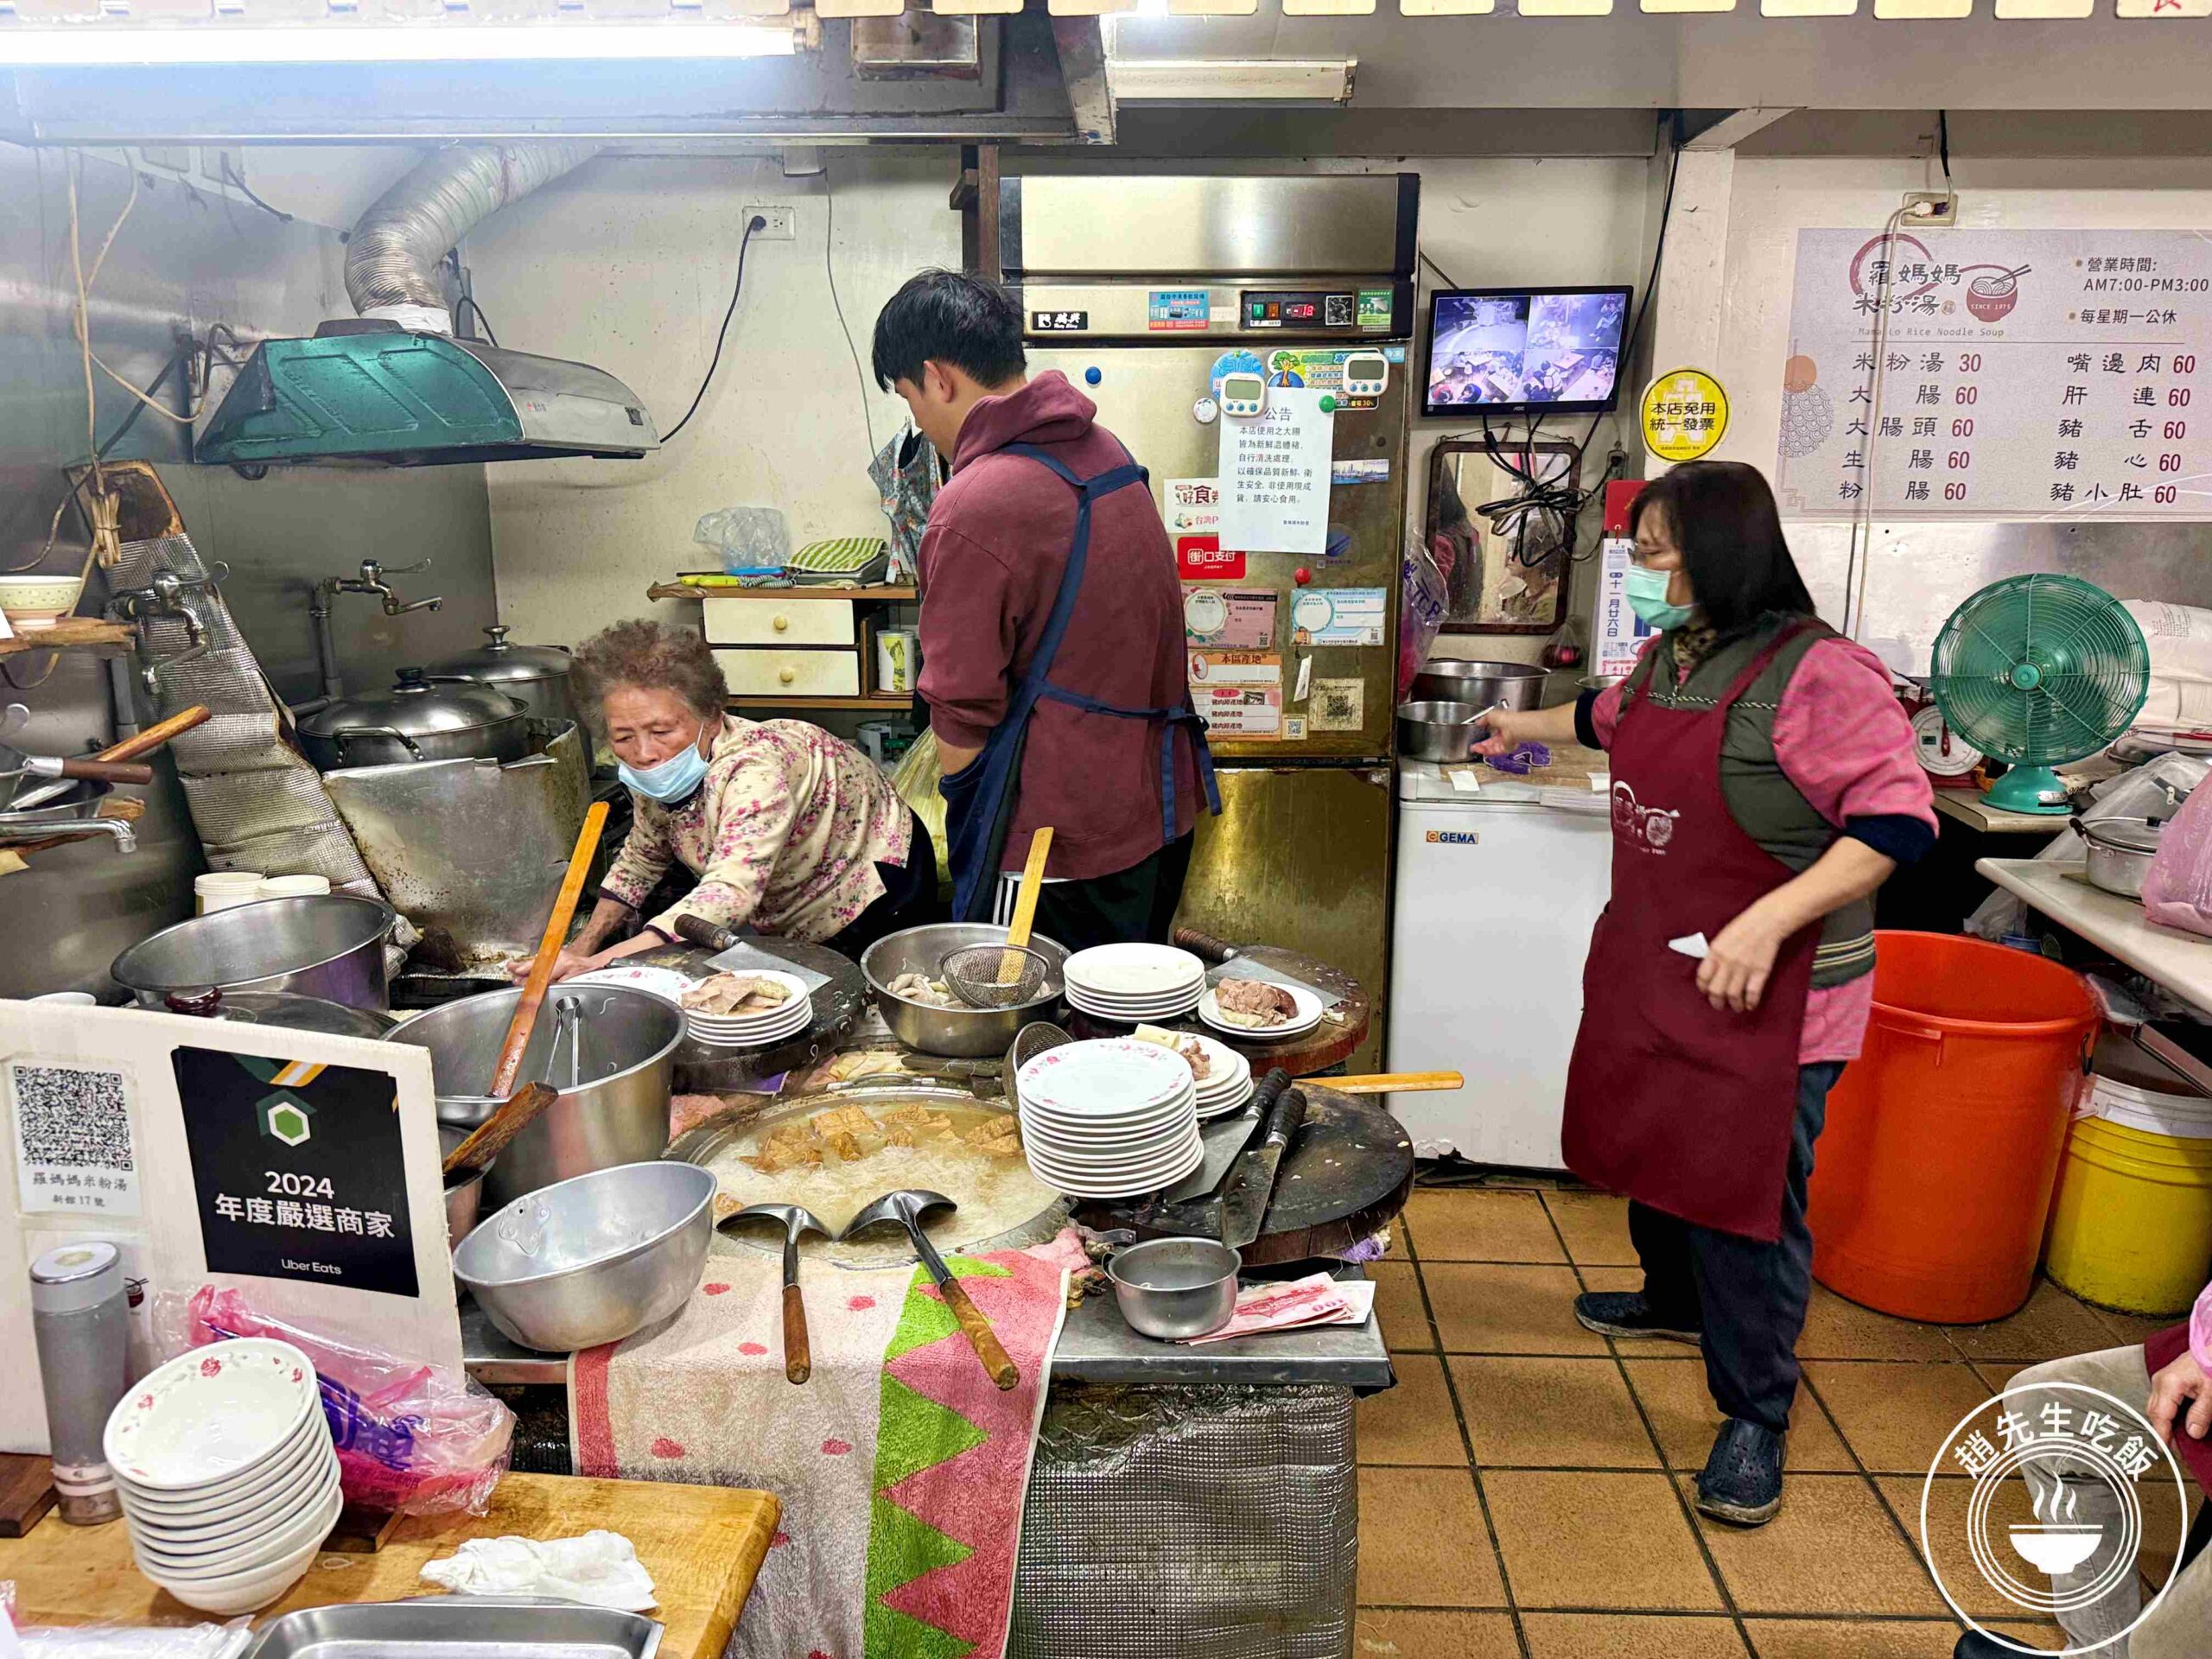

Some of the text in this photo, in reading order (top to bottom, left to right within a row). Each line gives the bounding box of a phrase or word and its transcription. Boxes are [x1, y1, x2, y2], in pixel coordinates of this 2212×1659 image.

[1868, 261, 1961, 286] 羅媽媽
[2088, 257, 2158, 272] 營業時間:
[2083, 278, 2209, 292] AM7:00-PM3:00
[1853, 292, 1941, 317] 米粉湯
[2081, 308, 2177, 324] 每星期一公休
[1889, 327, 1901, 336] Lo
[1907, 327, 1931, 336] Rice
[1937, 327, 1974, 336] Noodle
[1980, 327, 2004, 339] Soup
[1853, 353, 1981, 373] 米粉湯 30
[2067, 353, 2196, 373] 嘴邊肉 60
[1955, 386, 1977, 404] 60
[2168, 388, 2190, 406] 60
[1264, 406, 1293, 422] 公告
[1650, 402, 1716, 416] 本店免用
[1239, 426, 1300, 436] 本店使用之大腸
[1649, 417, 1715, 430] 統一發票
[1846, 416, 1974, 437] 大腸頭 60
[2164, 421, 2186, 439] 60
[1948, 451, 1970, 469] 60
[2159, 453, 2182, 472] 60
[1943, 483, 1967, 500] 60
[2050, 482, 2177, 504] 豬小肚 60
[1187, 549, 1236, 565] 街口支付
[1607, 579, 1622, 637] 十一月廿六日
[1440, 832, 1476, 843] GEMA
[33, 1172, 128, 1192] 羅媽媽米粉湯
[264, 1171, 335, 1200] 2024
[214, 1192, 396, 1239] 年度嚴選商家
[281, 1258, 342, 1275] Uber Eats
